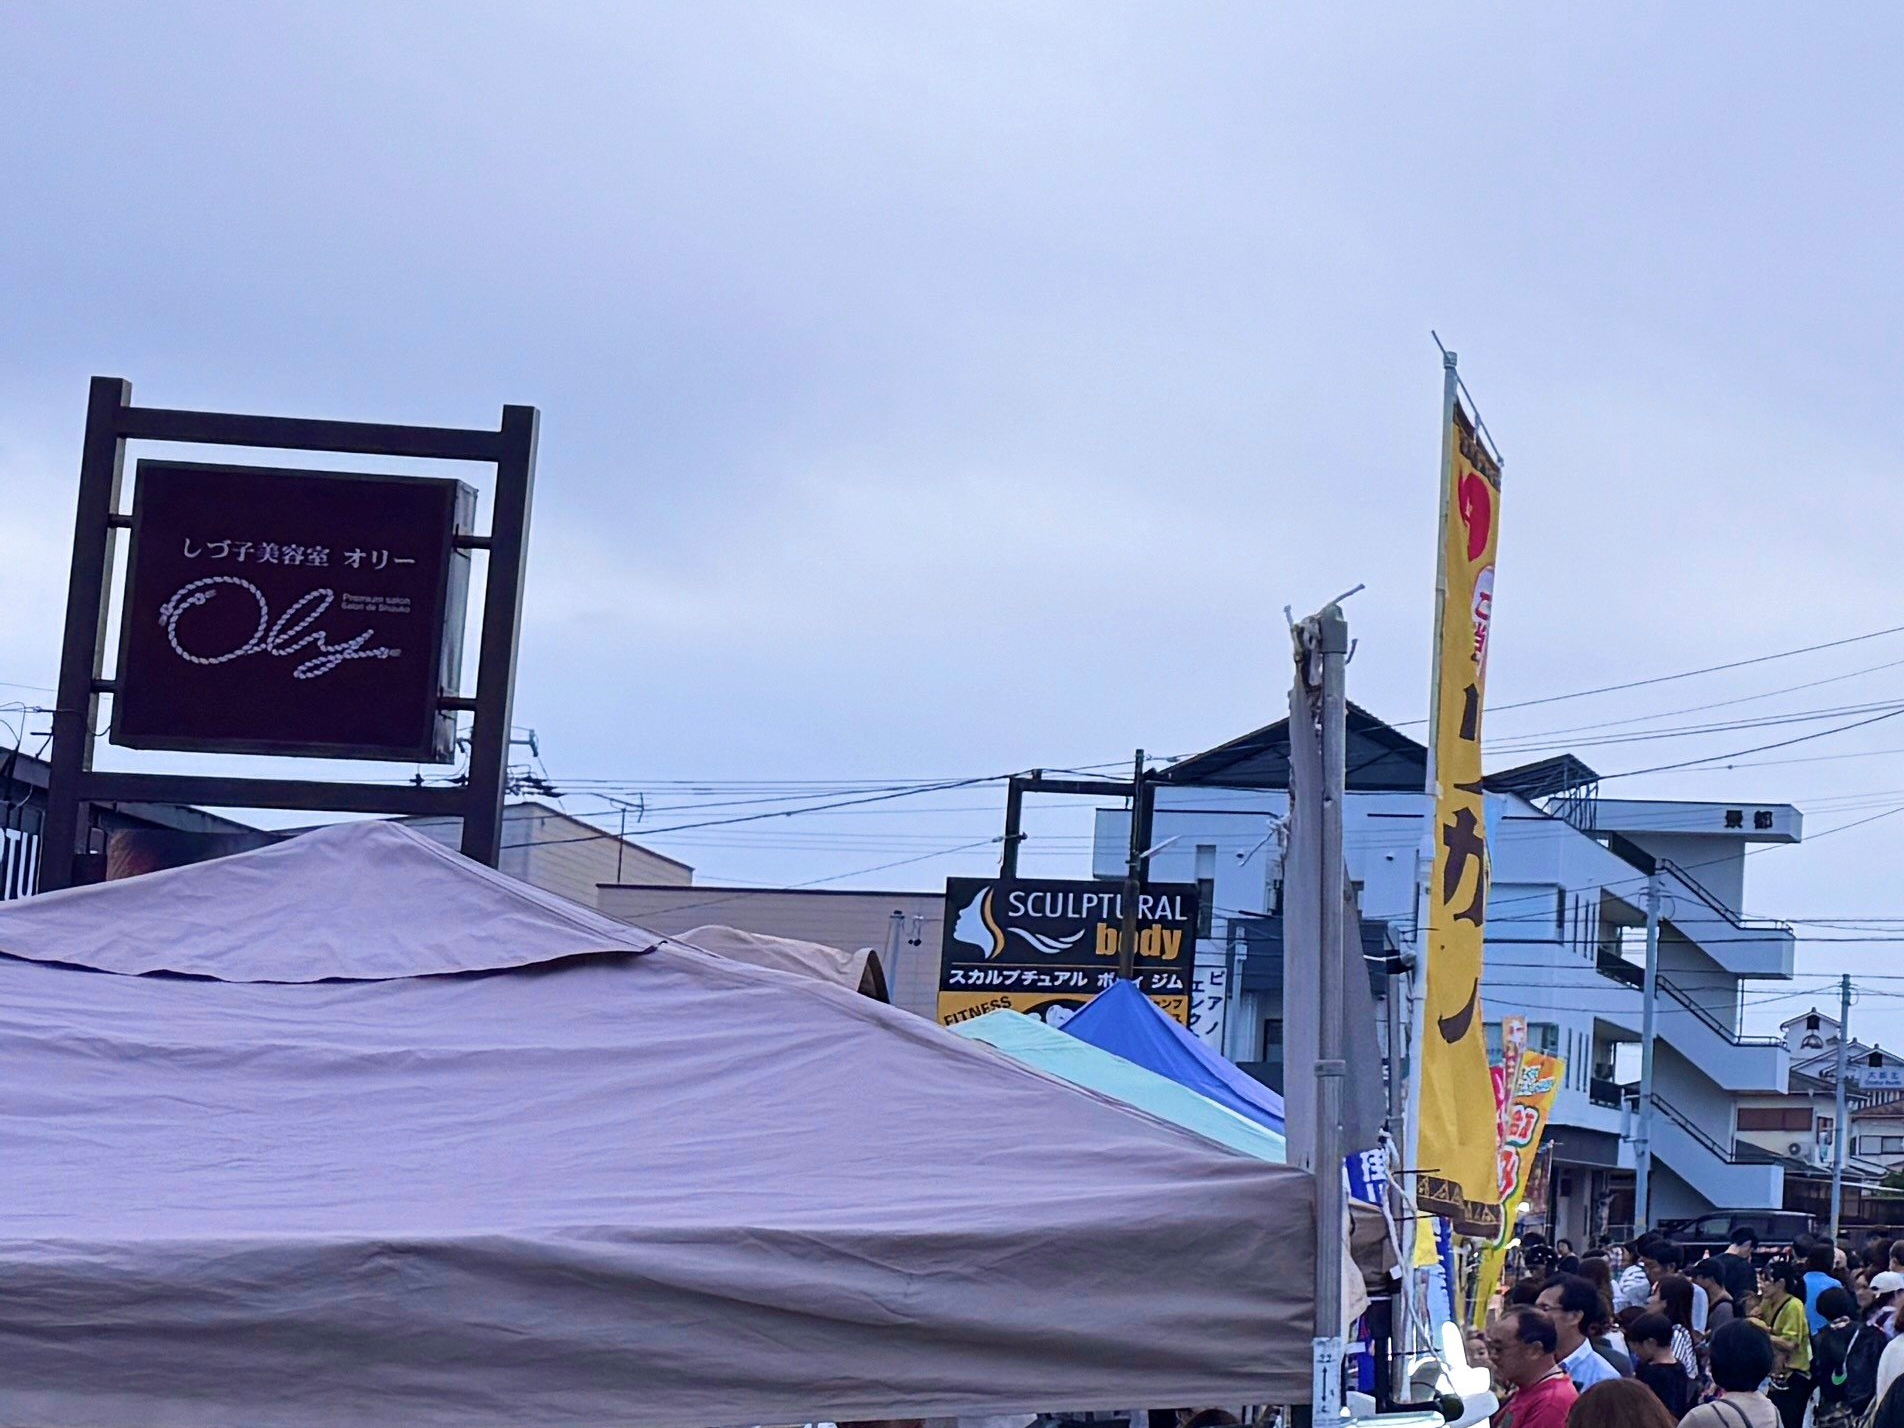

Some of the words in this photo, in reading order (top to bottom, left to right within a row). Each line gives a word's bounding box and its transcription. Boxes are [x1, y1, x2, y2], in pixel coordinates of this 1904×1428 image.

[183, 537, 330, 567] しづ子美容室
[344, 547, 416, 570] オリー
[1095, 923, 1183, 960] bdy
[943, 995, 1012, 1027] FITNESS
